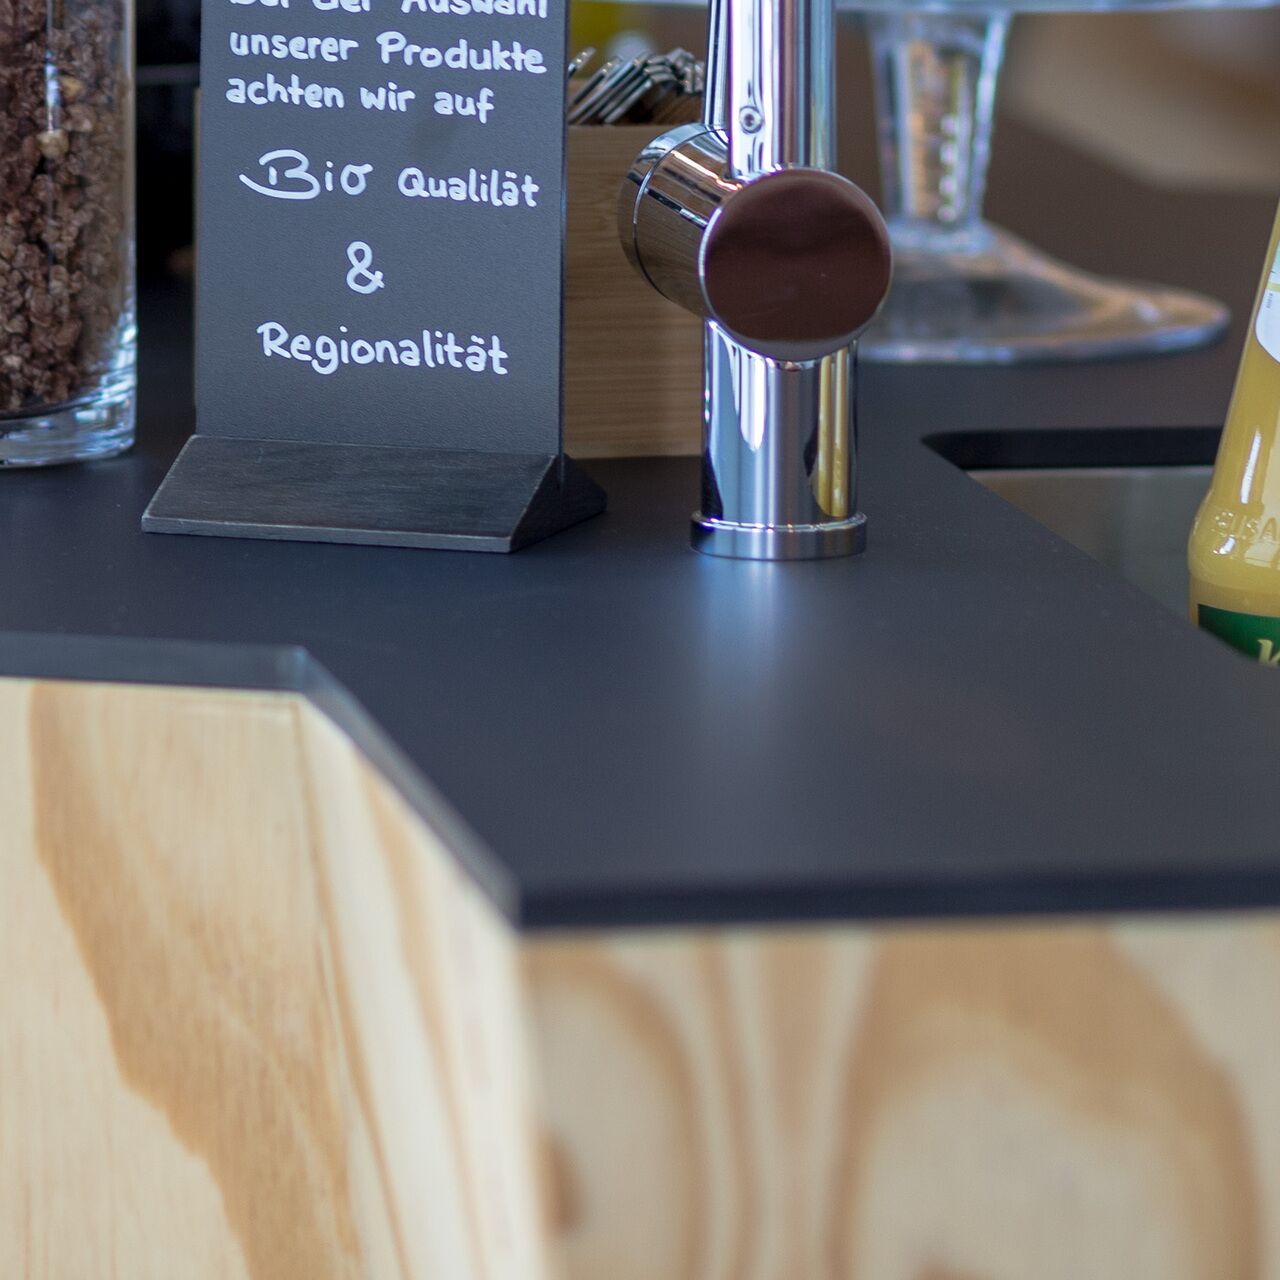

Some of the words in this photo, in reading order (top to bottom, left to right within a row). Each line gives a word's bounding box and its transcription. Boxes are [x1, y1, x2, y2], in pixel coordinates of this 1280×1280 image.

[229, 32, 359, 61] unserer
[376, 31, 547, 73] Produkte
[225, 73, 344, 108] achten
[360, 82, 415, 111] wir
[434, 88, 494, 123] auf
[239, 149, 373, 200] Bio
[346, 241, 385, 294] &
[256, 321, 508, 375] Regionalität
